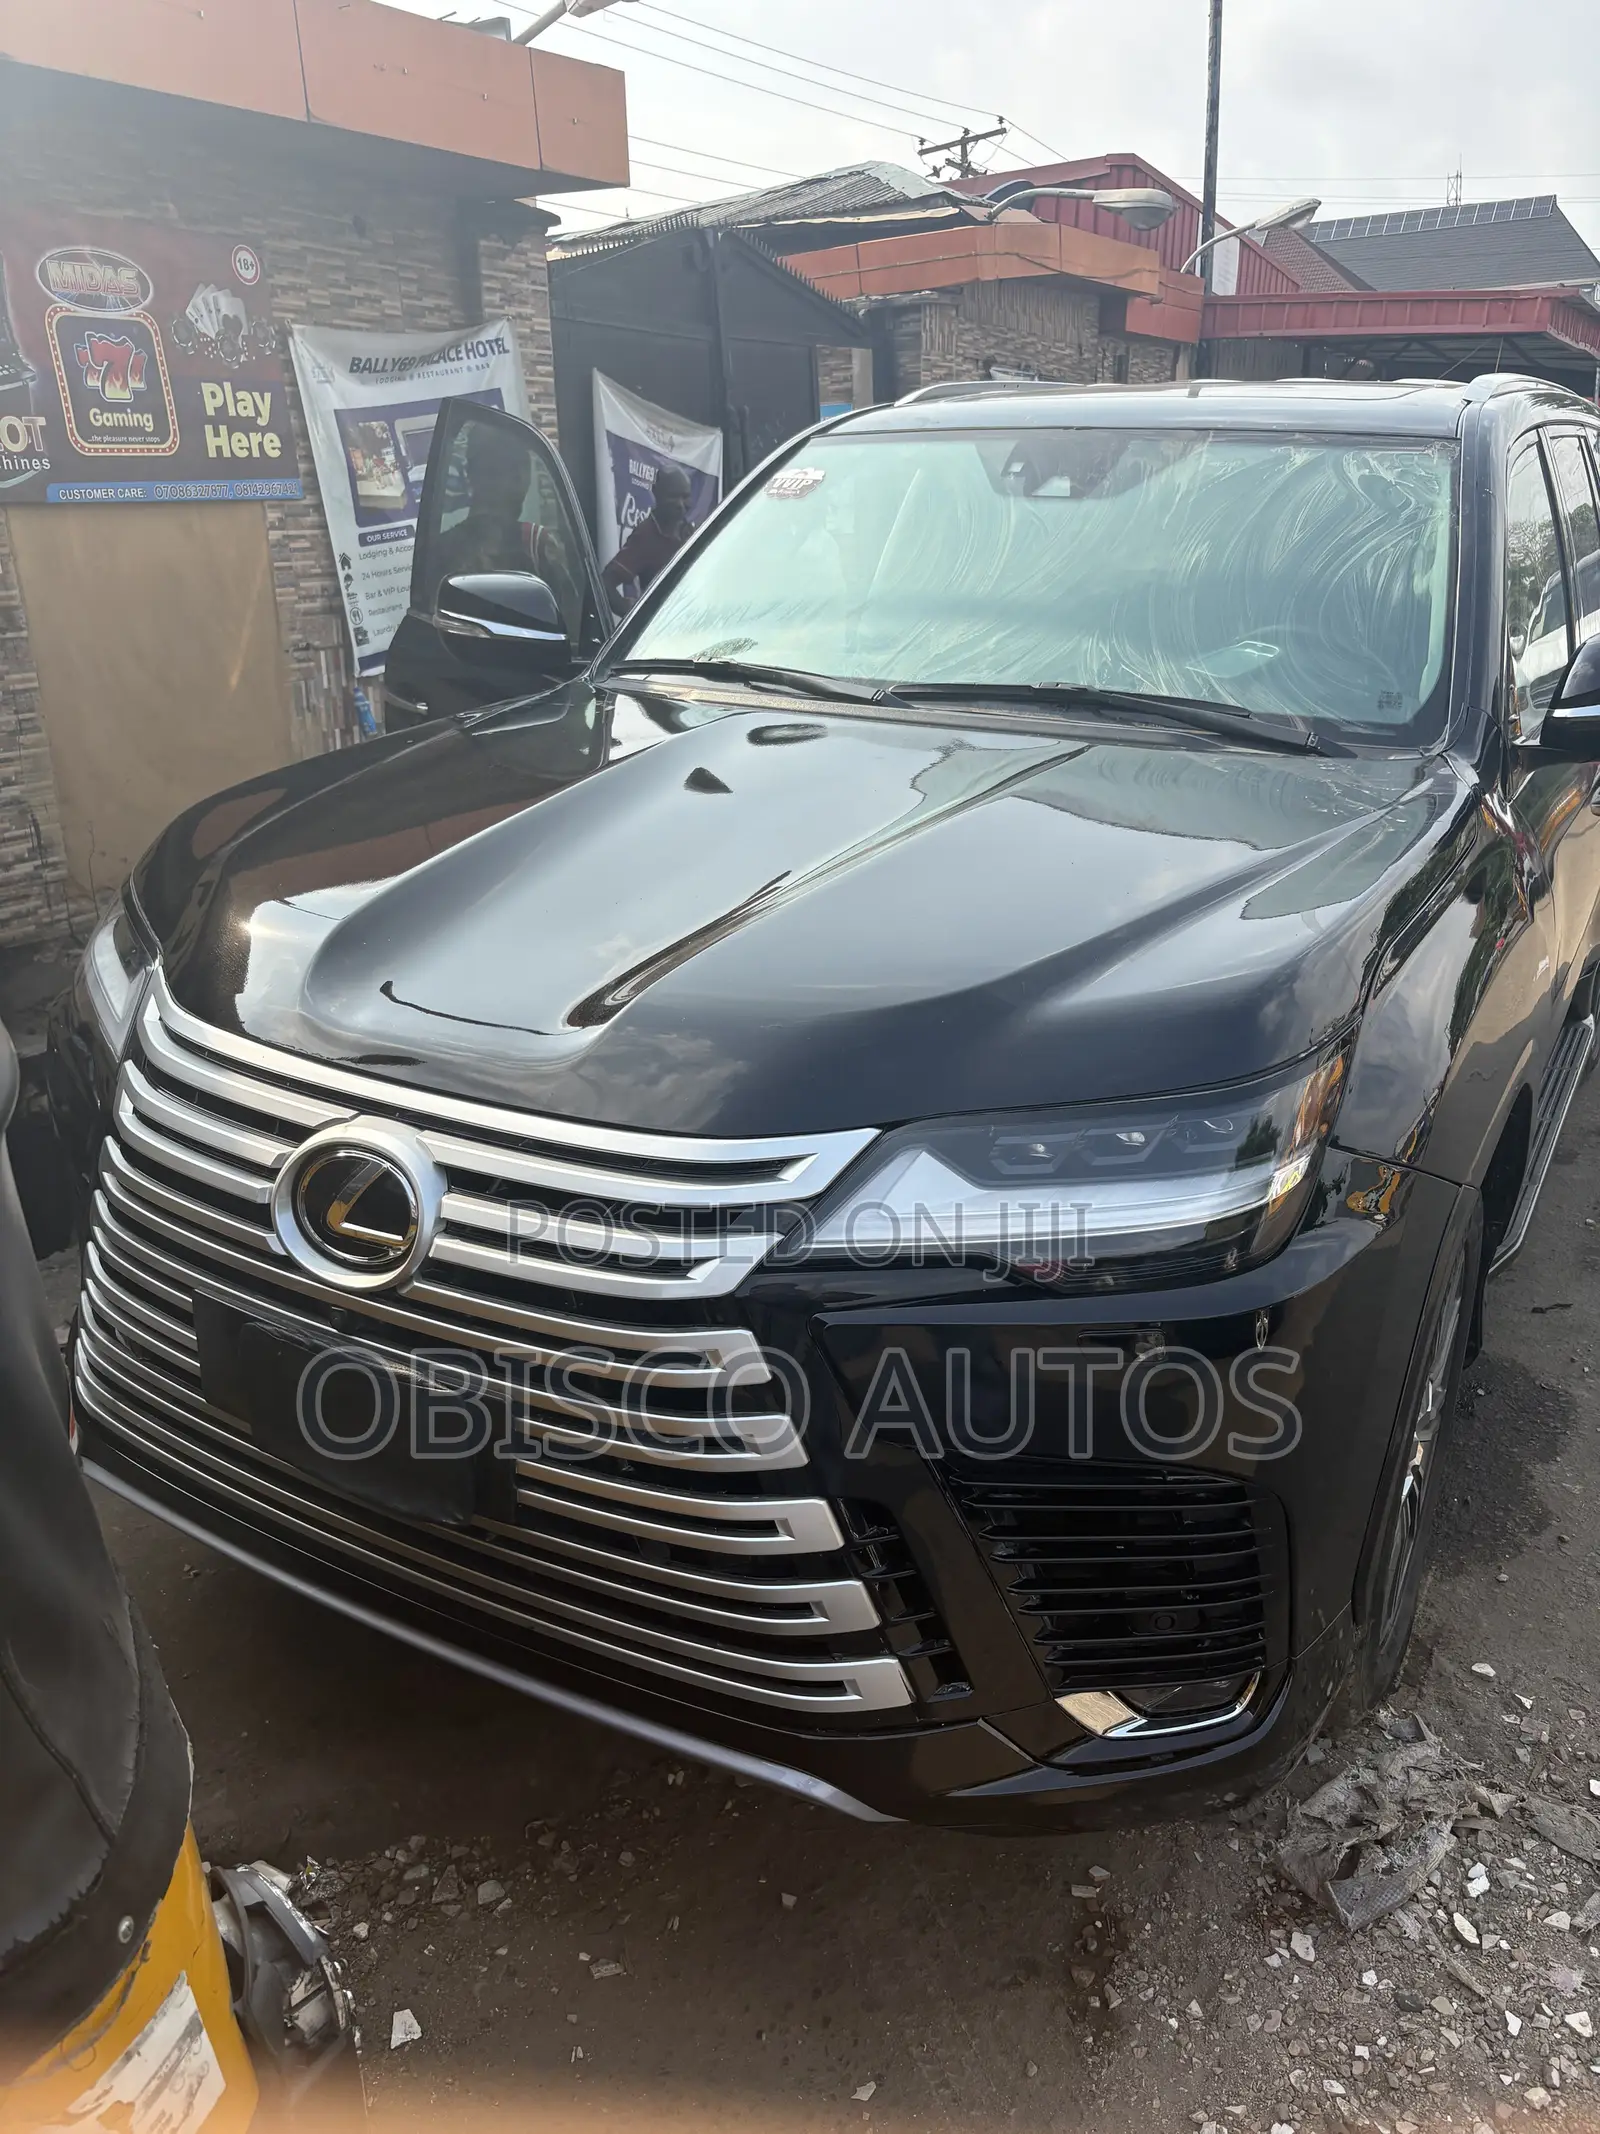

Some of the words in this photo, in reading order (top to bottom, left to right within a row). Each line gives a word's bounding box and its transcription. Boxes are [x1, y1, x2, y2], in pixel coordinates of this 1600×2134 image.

[236, 257, 256, 272] 18+
[46, 259, 140, 296] MIDAS
[349, 356, 416, 374] BALLY69
[464, 337, 509, 360] HOTEL
[201, 381, 272, 426] Play
[89, 408, 154, 432] Gaming
[0, 416, 46, 453] OT
[103, 435, 127, 443] pleasure
[205, 424, 282, 458] Here
[0, 456, 51, 471] hines
[59, 488, 115, 500] CUSTOMER
[117, 487, 147, 499] CARE:
[366, 533, 382, 543] OUR
[382, 528, 408, 540] SERVICE
[358, 548, 388, 561] Lodging
[361, 572, 371, 581] 24
[372, 568, 392, 578] Hours
[393, 563, 412, 575] Servic
[365, 591, 377, 601] Bar
[383, 586, 396, 597] VIP
[396, 585, 410, 594] Lou
[368, 603, 403, 616] Restaurant
